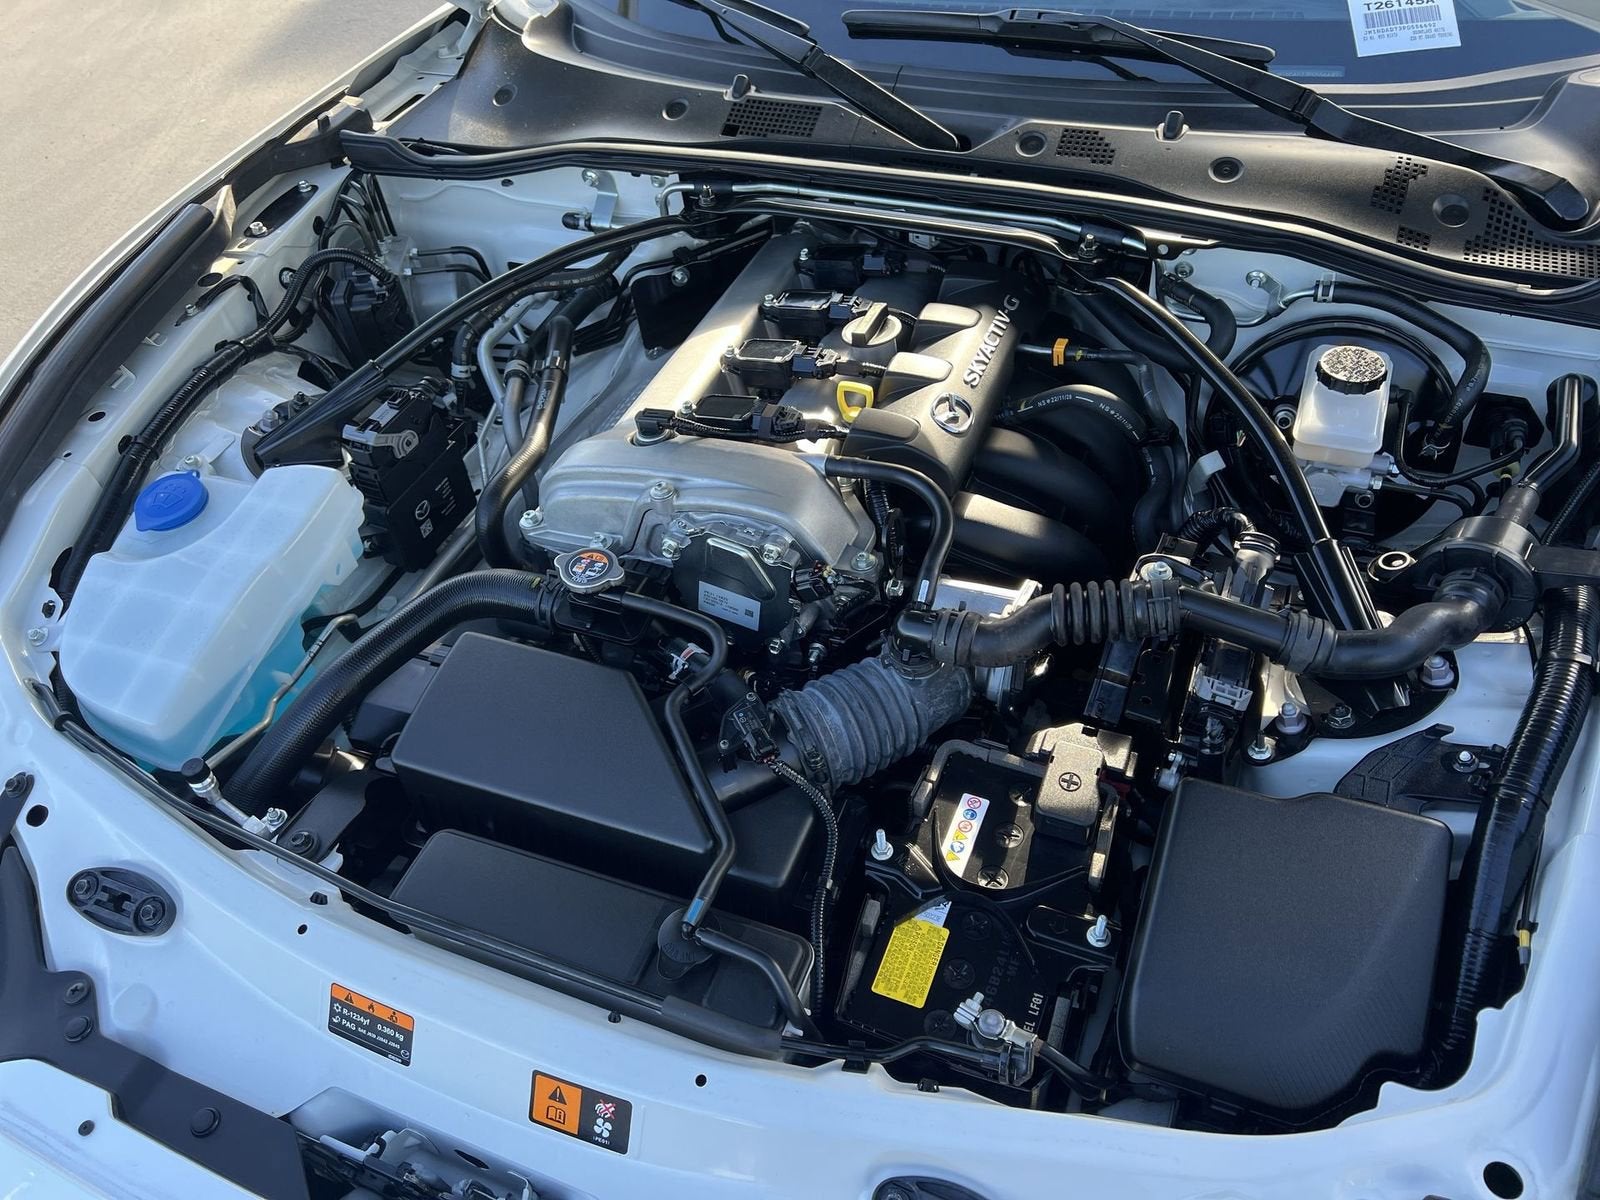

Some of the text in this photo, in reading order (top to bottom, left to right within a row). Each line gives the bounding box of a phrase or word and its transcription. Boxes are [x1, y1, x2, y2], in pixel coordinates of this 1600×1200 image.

[963, 294, 1020, 389] SKYACTIV-G
[341, 1018, 356, 1031] PAG
[395, 1031, 404, 1042] kg
